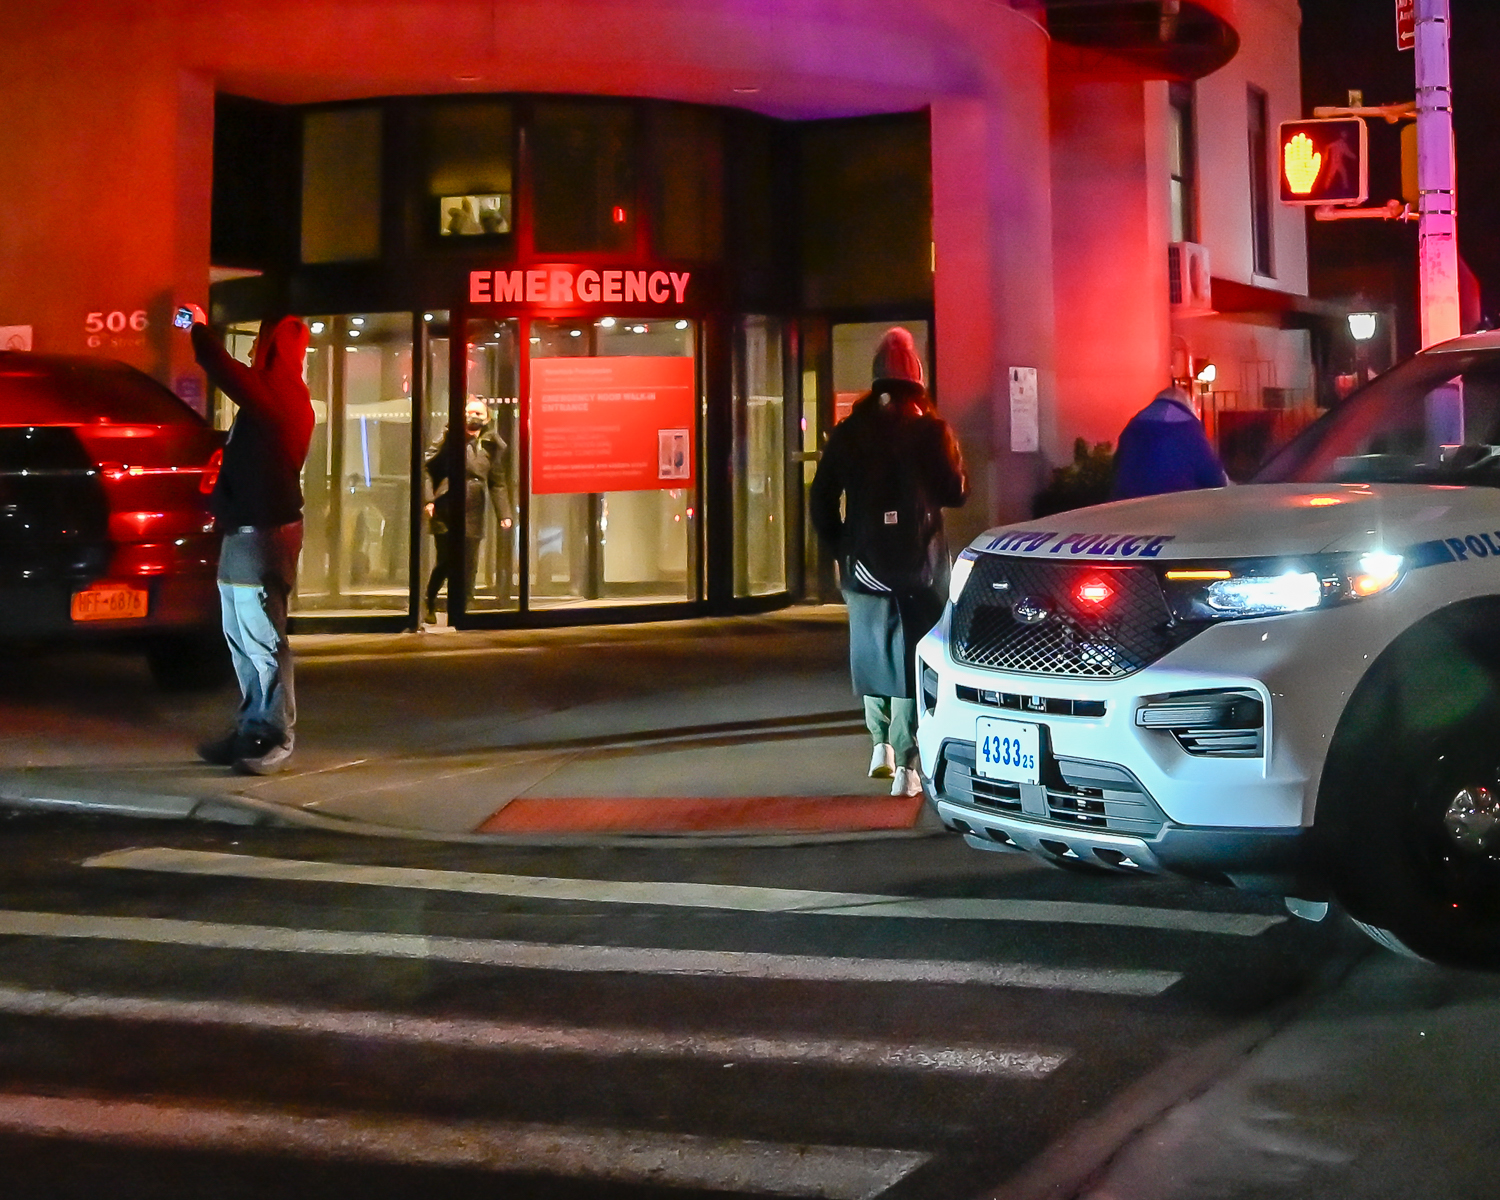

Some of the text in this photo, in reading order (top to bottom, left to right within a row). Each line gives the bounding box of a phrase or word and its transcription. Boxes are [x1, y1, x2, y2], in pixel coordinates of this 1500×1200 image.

[469, 269, 691, 303] EMERGENCY
[84, 310, 150, 333] 506
[985, 530, 1176, 557] NYPD POLICE
[982, 735, 1035, 769] 4333 25
